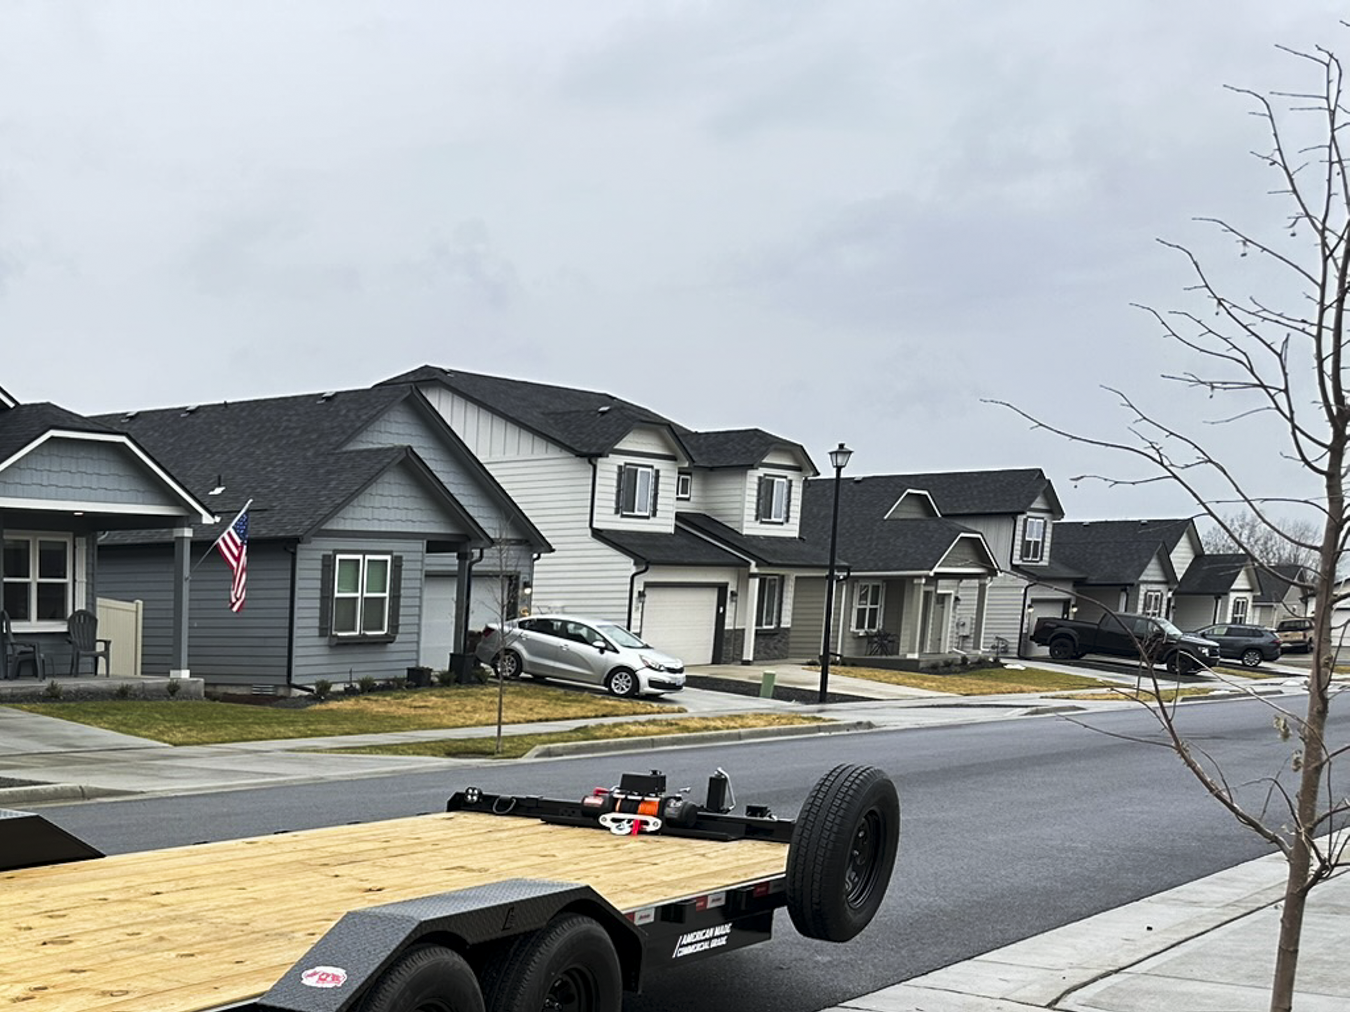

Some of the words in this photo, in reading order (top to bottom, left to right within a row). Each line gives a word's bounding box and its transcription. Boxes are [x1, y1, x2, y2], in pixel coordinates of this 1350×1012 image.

[681, 927, 714, 945] AMERICAN
[714, 922, 733, 936] MADE
[677, 940, 710, 957] COMMERCIAL
[710, 935, 728, 948] GRADE
